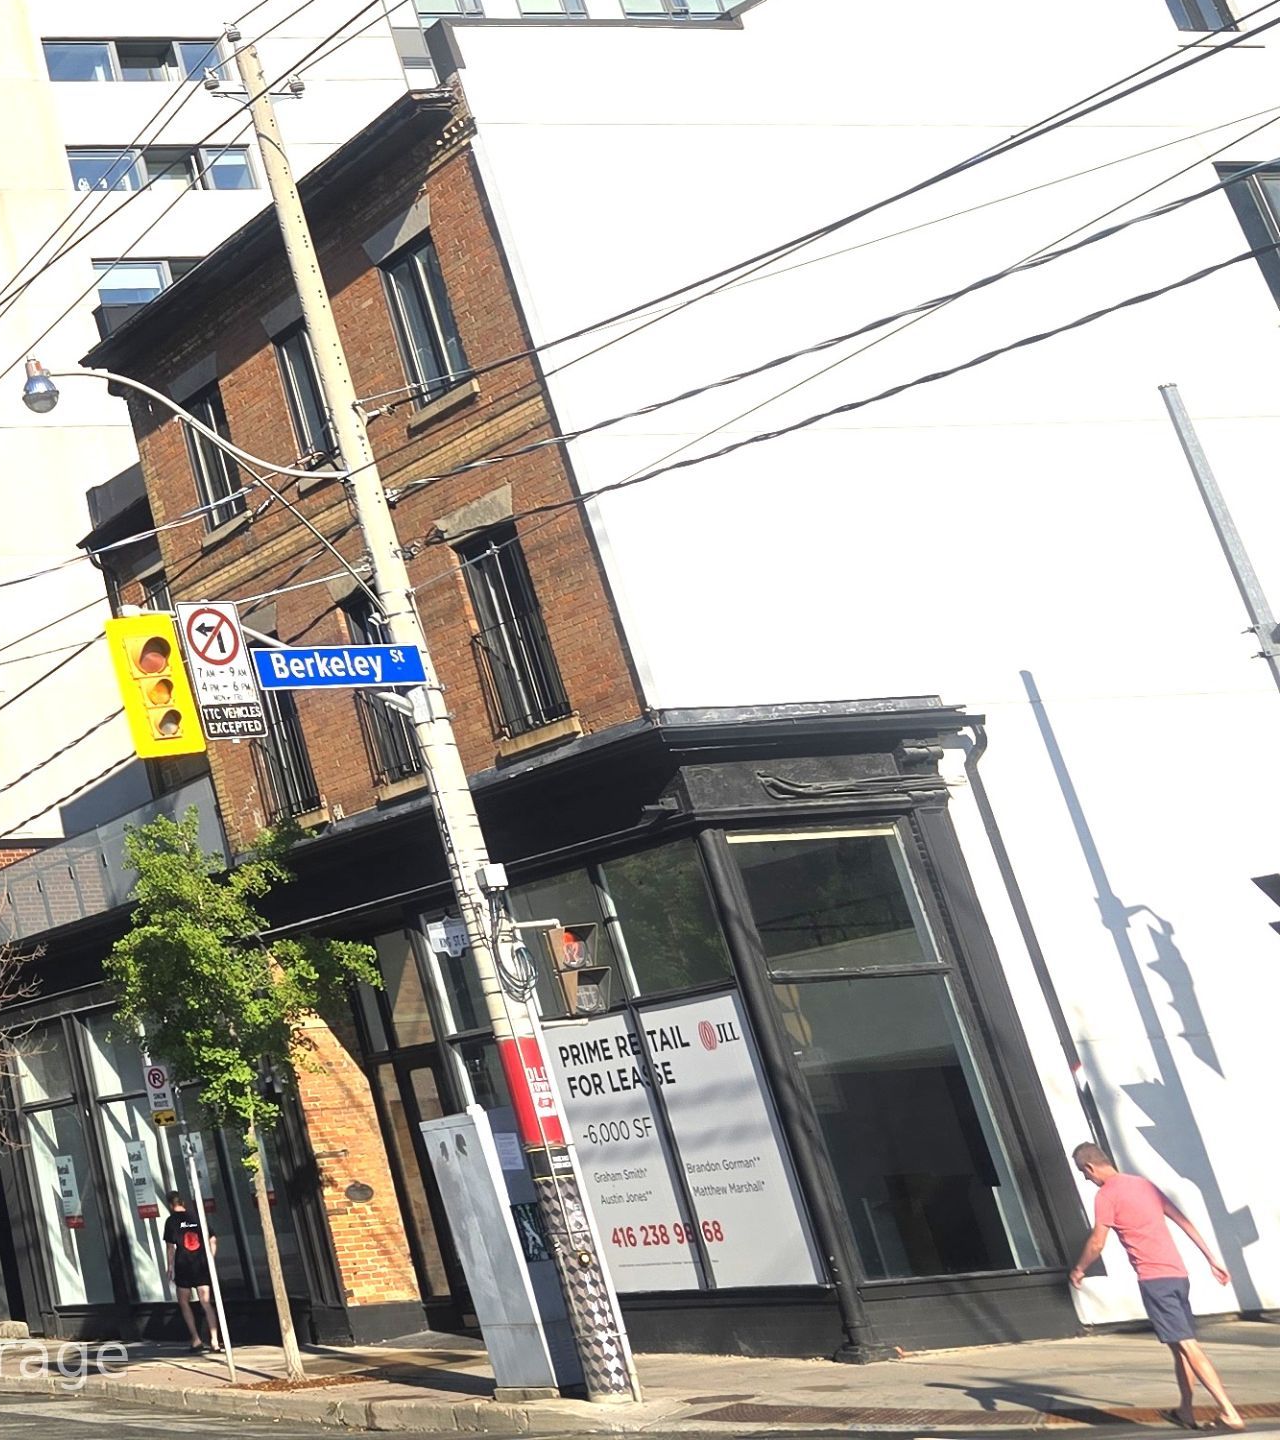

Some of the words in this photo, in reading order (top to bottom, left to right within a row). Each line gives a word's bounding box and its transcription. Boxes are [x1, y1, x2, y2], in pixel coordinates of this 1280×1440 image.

[270, 650, 383, 683] Berkeley
[390, 649, 405, 663] St
[203, 708, 221, 720] TTC
[222, 706, 262, 719] VEHICLES
[209, 720, 262, 734] EXCEPTED
[716, 1022, 740, 1044] JLL
[558, 1038, 613, 1067] PRIME
[615, 1026, 690, 1058] RETAIL
[567, 1073, 606, 1098] FOR
[607, 1062, 676, 1092] LEASE
[633, 1117, 652, 1138] SF
[686, 1161, 721, 1174] Brandon
[593, 1171, 622, 1183] Graham
[600, 1193, 625, 1205] Austin
[692, 1185, 727, 1197] Matthew
[611, 1226, 637, 1248] 416
[640, 1224, 670, 1246] 238
